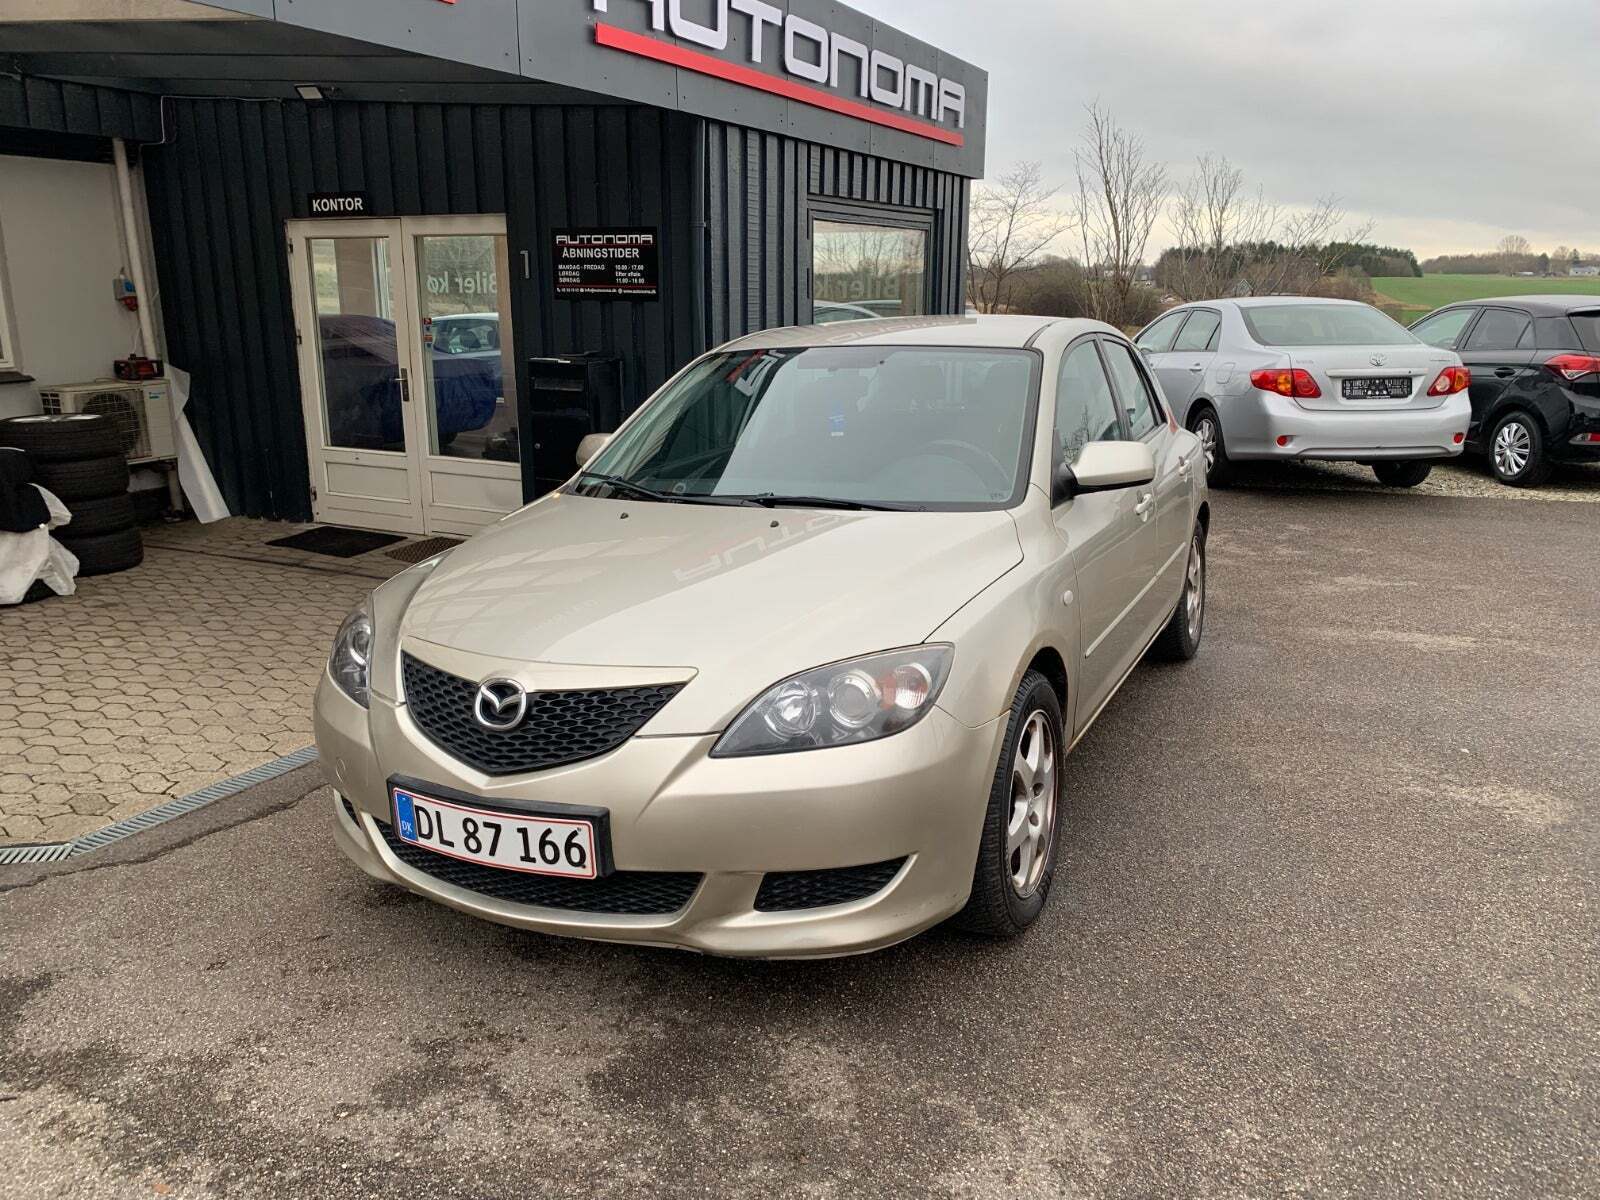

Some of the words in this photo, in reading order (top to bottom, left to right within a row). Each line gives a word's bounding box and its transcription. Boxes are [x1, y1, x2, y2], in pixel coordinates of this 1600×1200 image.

[312, 198, 364, 212] KONTOR
[556, 234, 653, 245] AUTONOMA
[562, 246, 640, 258] ÅBNINGSTIDER
[401, 821, 413, 834] DK
[414, 805, 455, 848] DL
[462, 817, 502, 857] 87
[516, 827, 587, 869] 166
